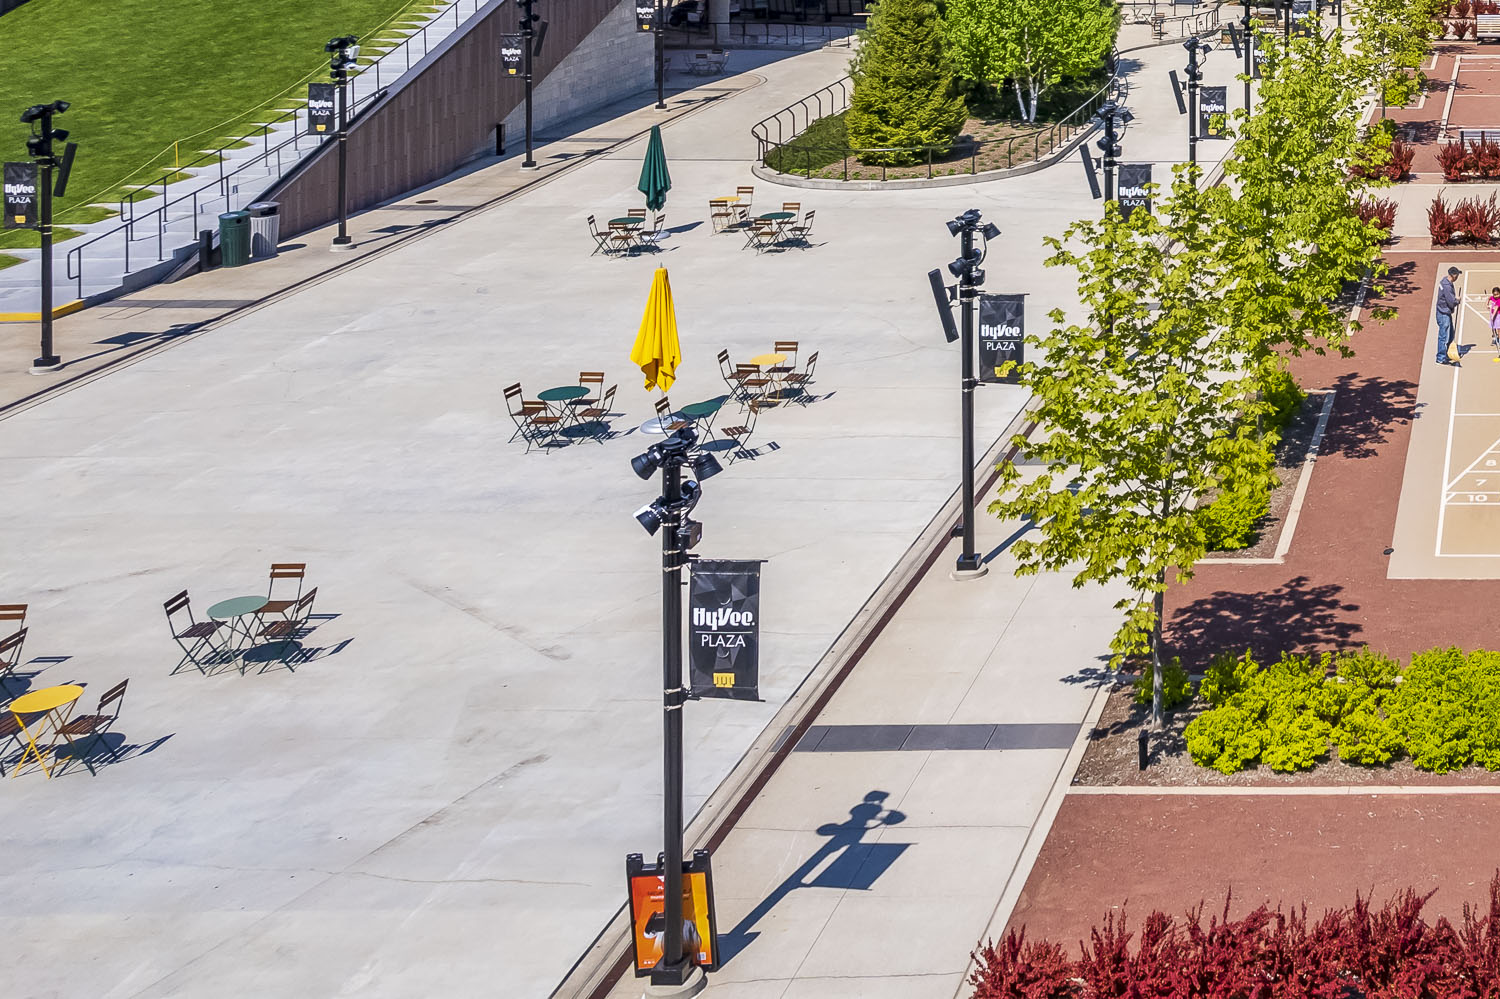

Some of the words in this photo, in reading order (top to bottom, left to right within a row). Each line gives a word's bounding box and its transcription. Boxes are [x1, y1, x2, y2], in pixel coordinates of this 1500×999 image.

[986, 342, 1016, 350] PLAZA
[1467, 494, 1488, 502] 10
[701, 634, 746, 648] PLAZA
